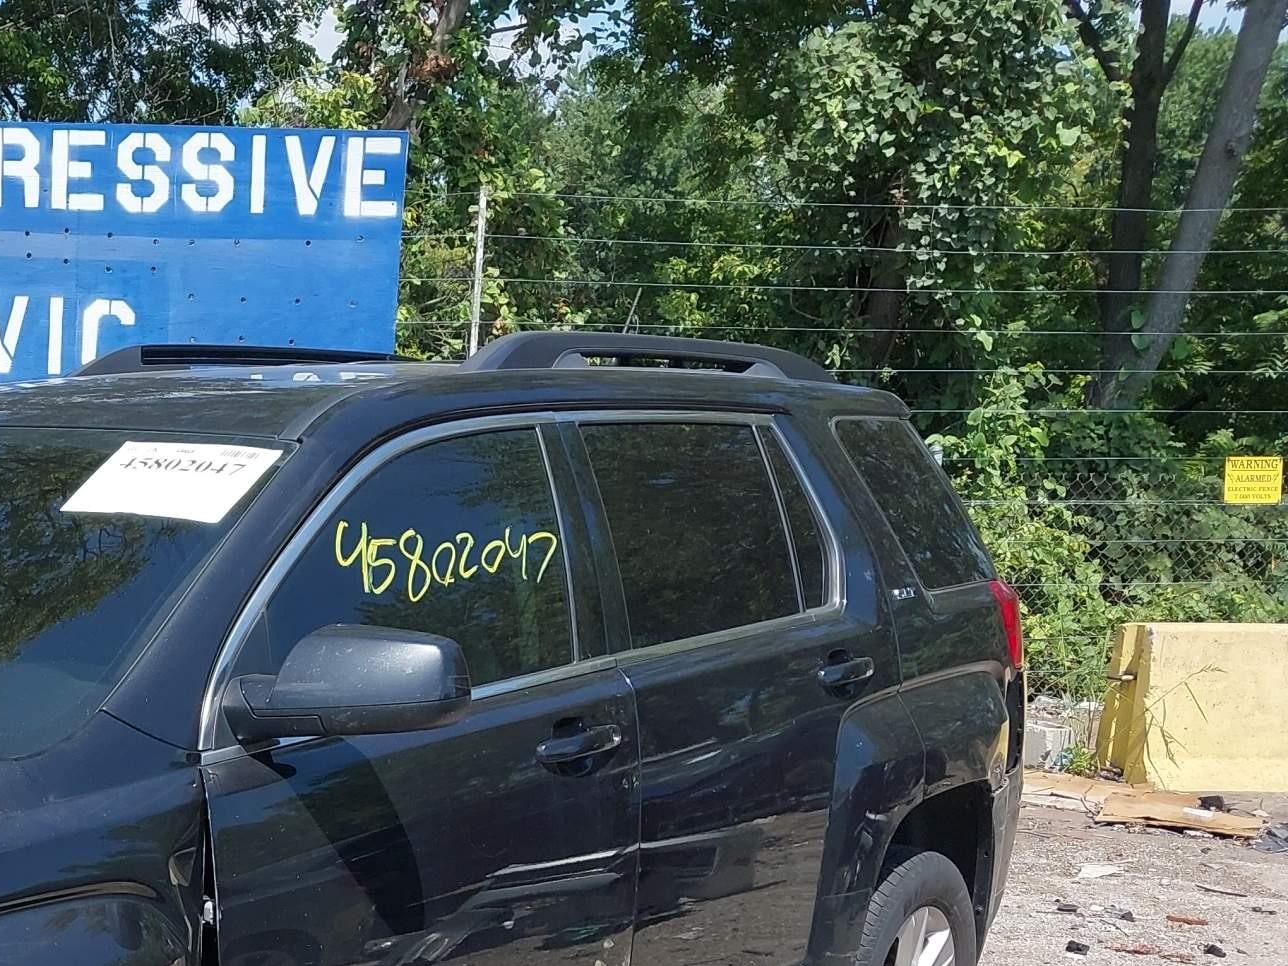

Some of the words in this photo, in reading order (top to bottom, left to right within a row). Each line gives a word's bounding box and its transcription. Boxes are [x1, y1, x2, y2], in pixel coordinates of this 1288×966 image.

[119, 456, 248, 477] 45802047
[1229, 459, 1279, 470] WARNING
[1235, 474, 1272, 483] ALARMED
[335, 520, 558, 602] 45802047
